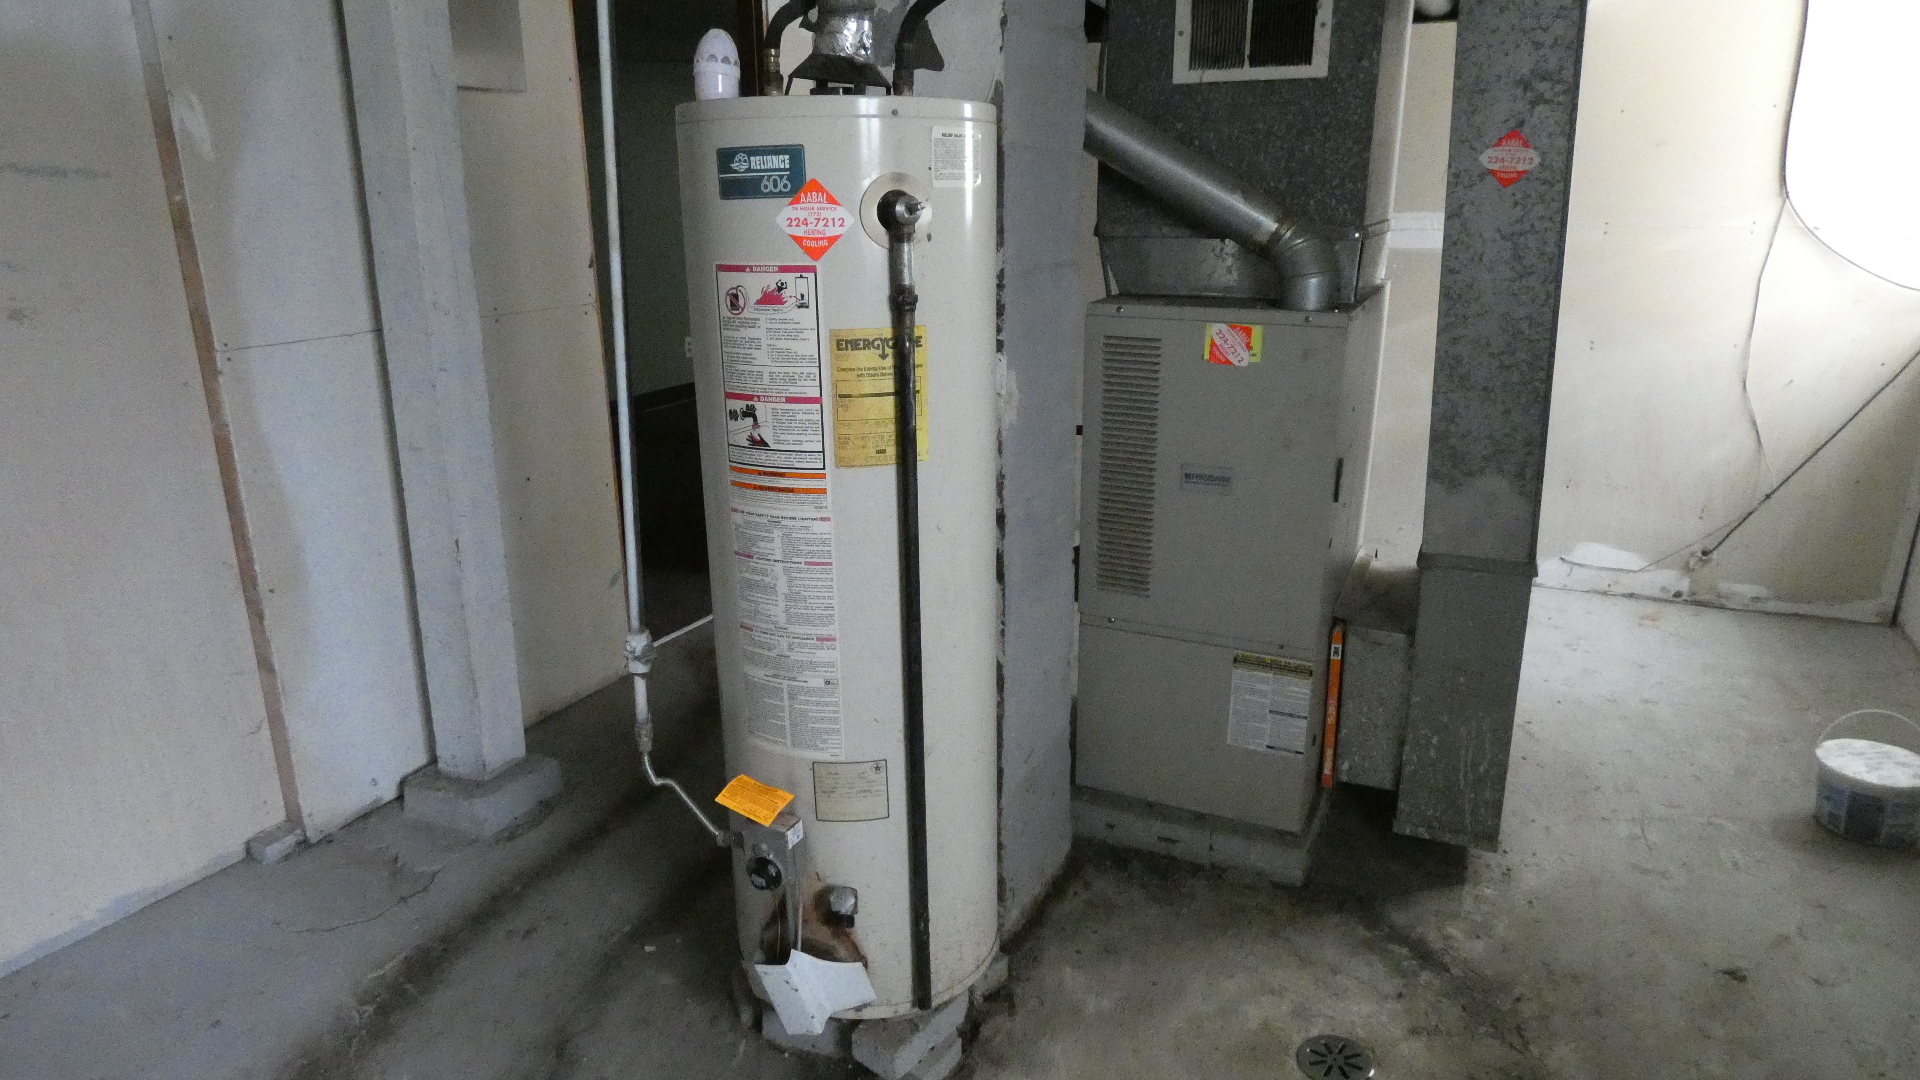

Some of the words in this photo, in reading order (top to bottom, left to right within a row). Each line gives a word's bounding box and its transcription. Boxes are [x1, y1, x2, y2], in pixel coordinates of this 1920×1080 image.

[750, 154, 790, 170] RELIANCE
[1487, 156, 1534, 165] 224-7212
[760, 175, 791, 193] 606
[800, 191, 828, 204] AABAL
[786, 217, 846, 228] 224-7212
[803, 228, 826, 236] HEATING
[802, 239, 829, 247] COOLING
[1216, 329, 1245, 364] 224-7212
[760, 395, 786, 403] DANGER
